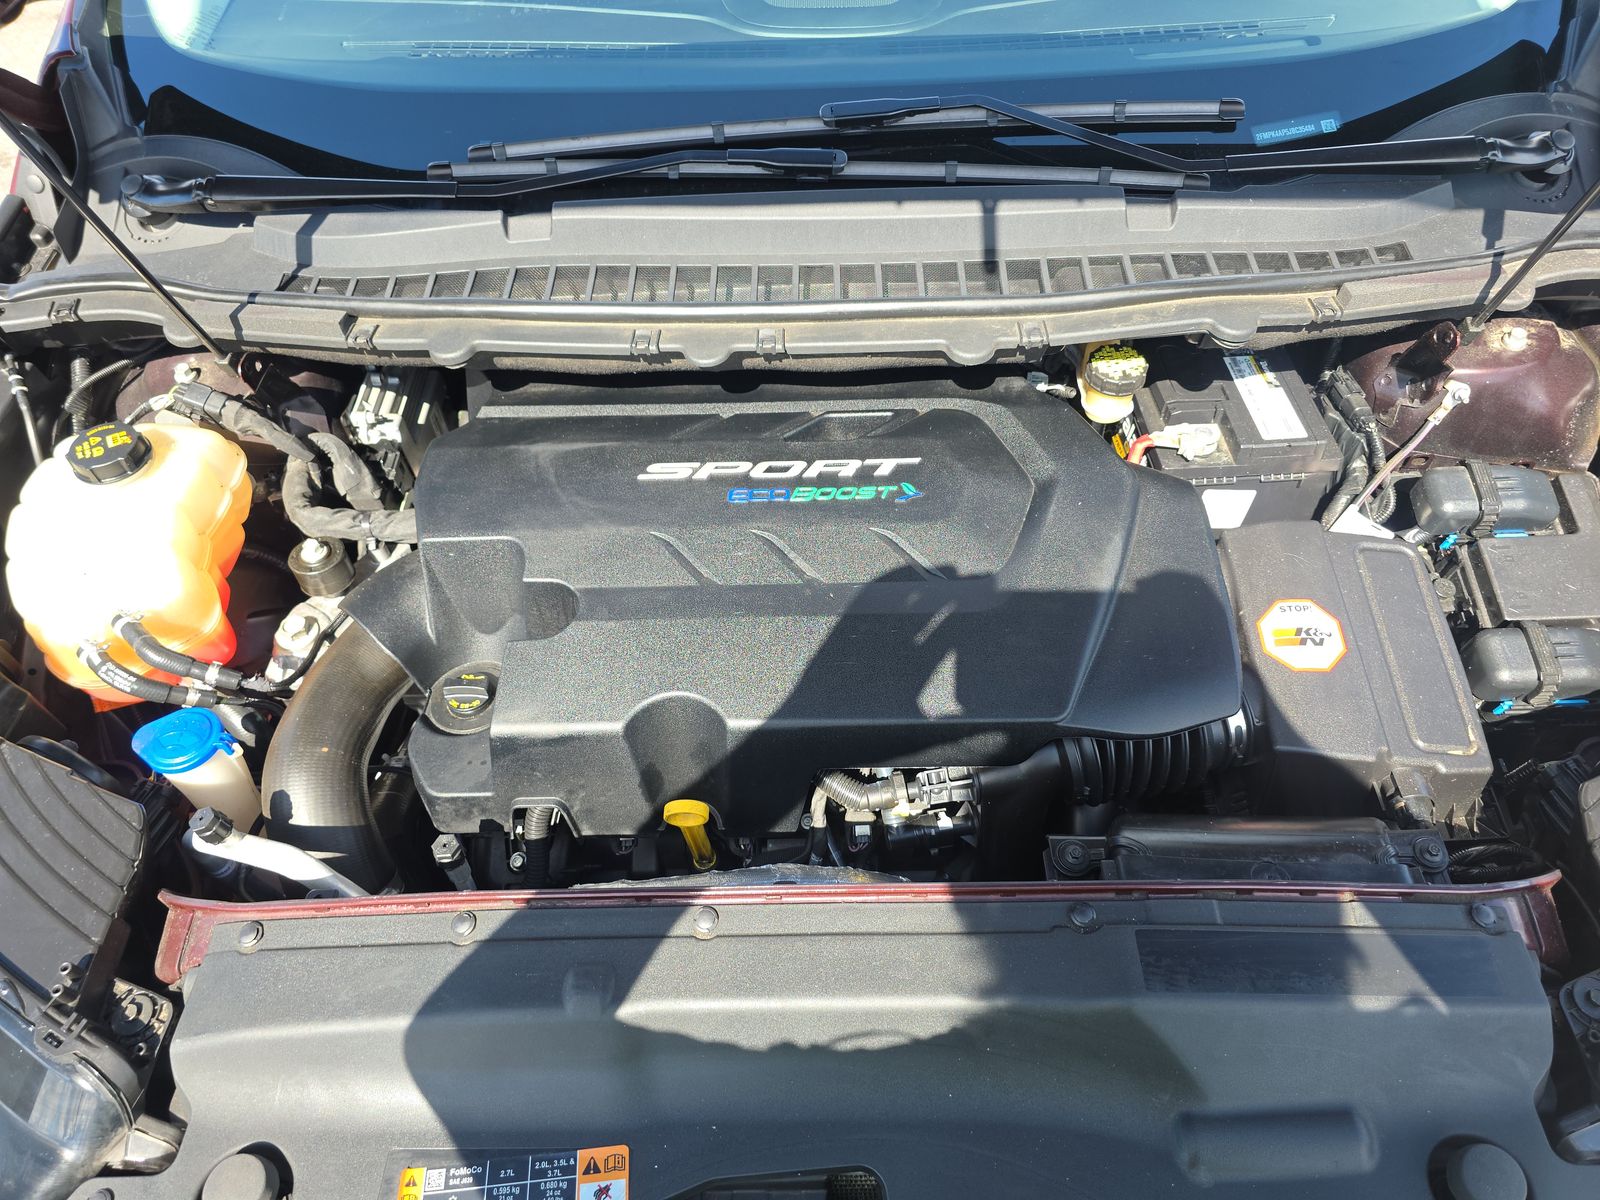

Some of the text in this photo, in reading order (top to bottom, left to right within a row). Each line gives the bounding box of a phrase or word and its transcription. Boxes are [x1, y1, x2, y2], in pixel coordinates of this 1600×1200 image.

[637, 457, 922, 480] SPORT
[449, 1166, 482, 1176] FoMoCo
[499, 1169, 515, 1178] 2.7L
[547, 1169, 562, 1177] 3.7L
[559, 1180, 568, 1189] kg
[492, 1185, 520, 1196] 0.595 kg
